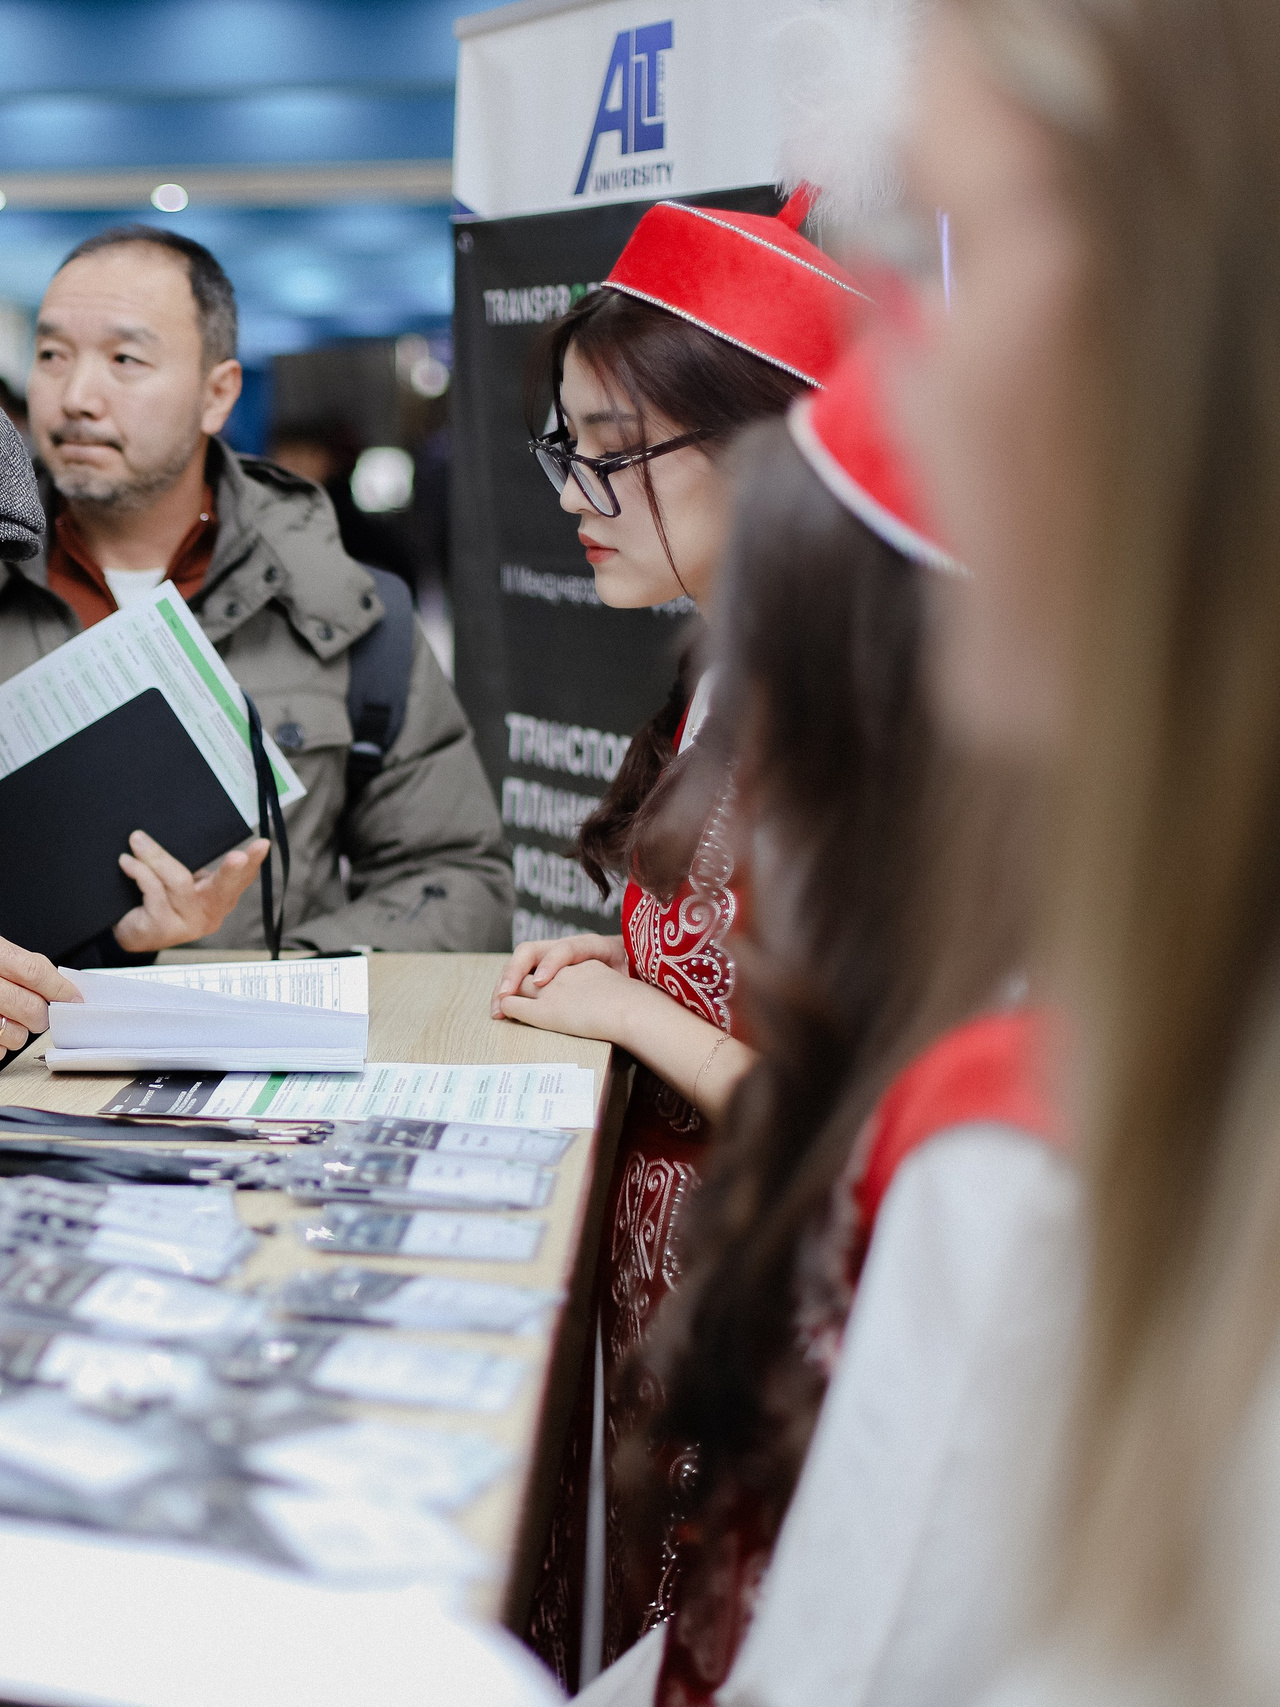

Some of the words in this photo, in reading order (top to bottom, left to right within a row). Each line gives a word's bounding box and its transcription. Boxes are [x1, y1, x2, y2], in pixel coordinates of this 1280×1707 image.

[574, 19, 673, 195] ALT
[593, 160, 673, 194] UNIVERSITY
[505, 712, 633, 783] ТРАНСПО
